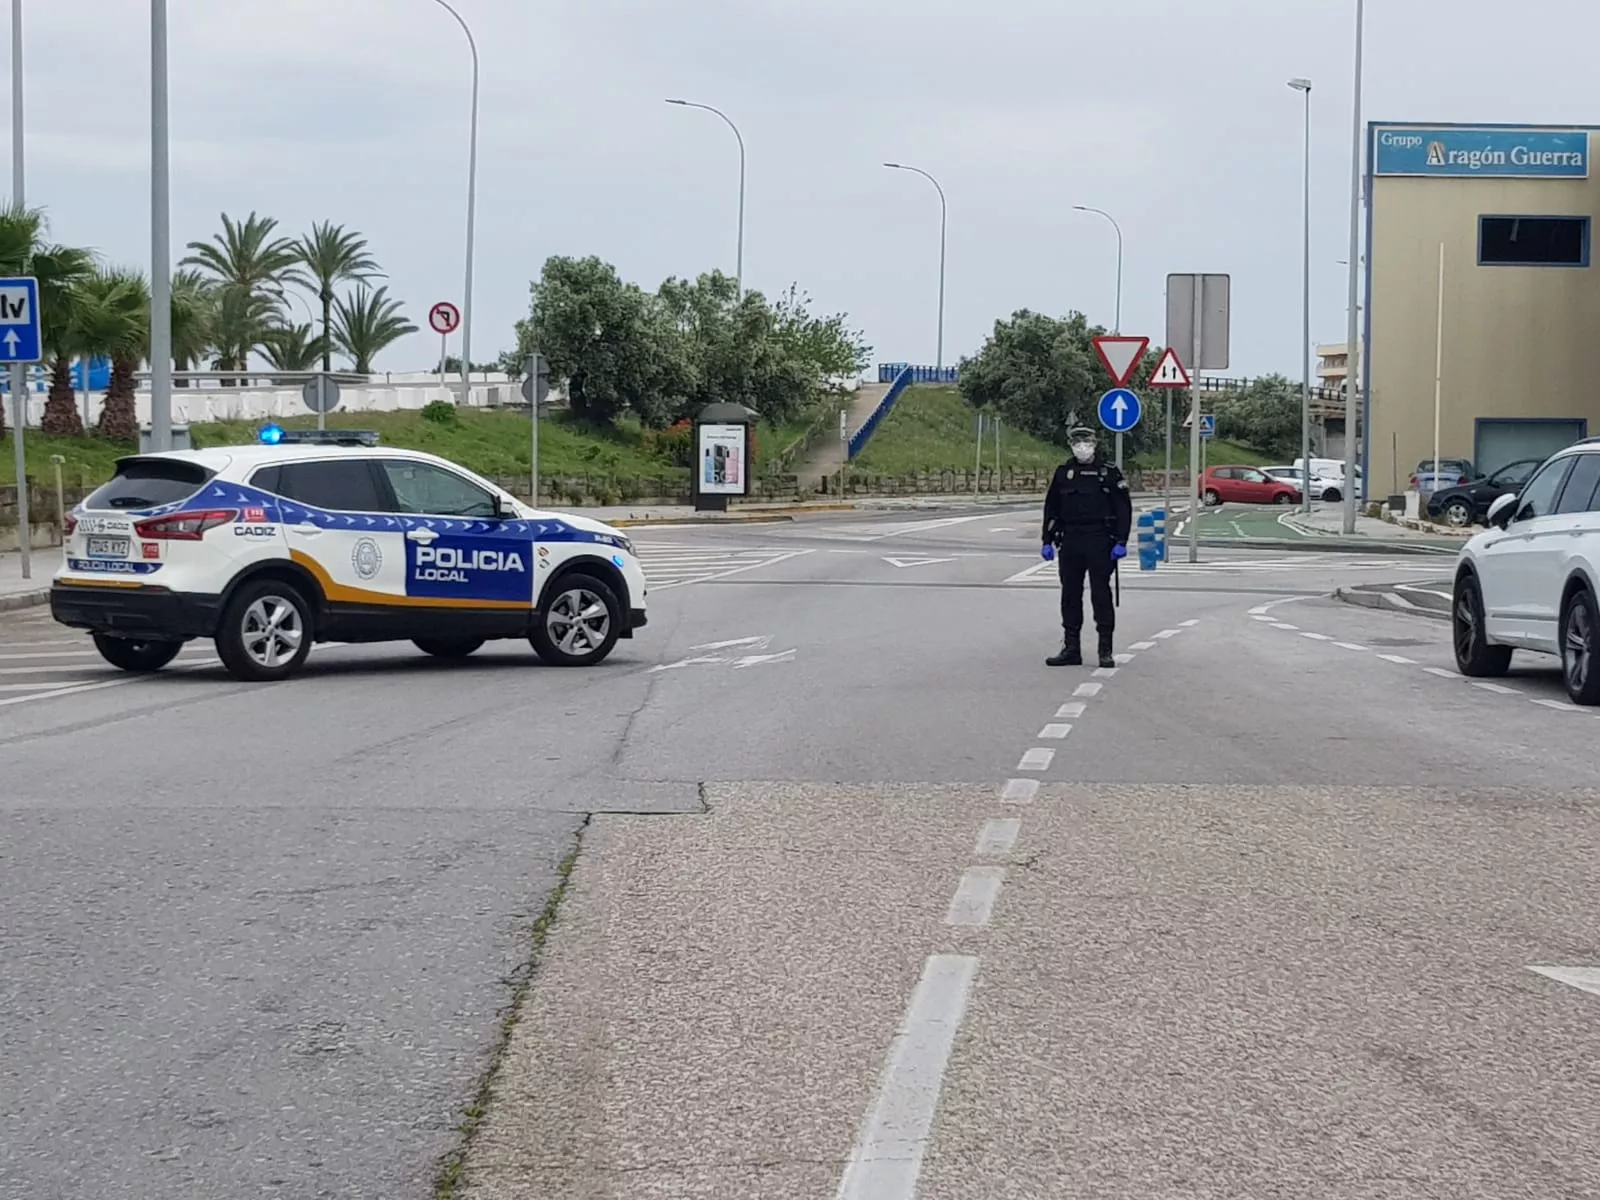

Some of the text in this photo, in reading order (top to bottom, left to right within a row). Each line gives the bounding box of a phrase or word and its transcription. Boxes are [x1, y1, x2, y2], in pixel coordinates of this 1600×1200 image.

[1381, 132, 1423, 148] Grupo
[1426, 141, 1583, 169] Aragón Guerra
[416, 546, 525, 572] POLICIA
[415, 567, 469, 582] LOCAL
